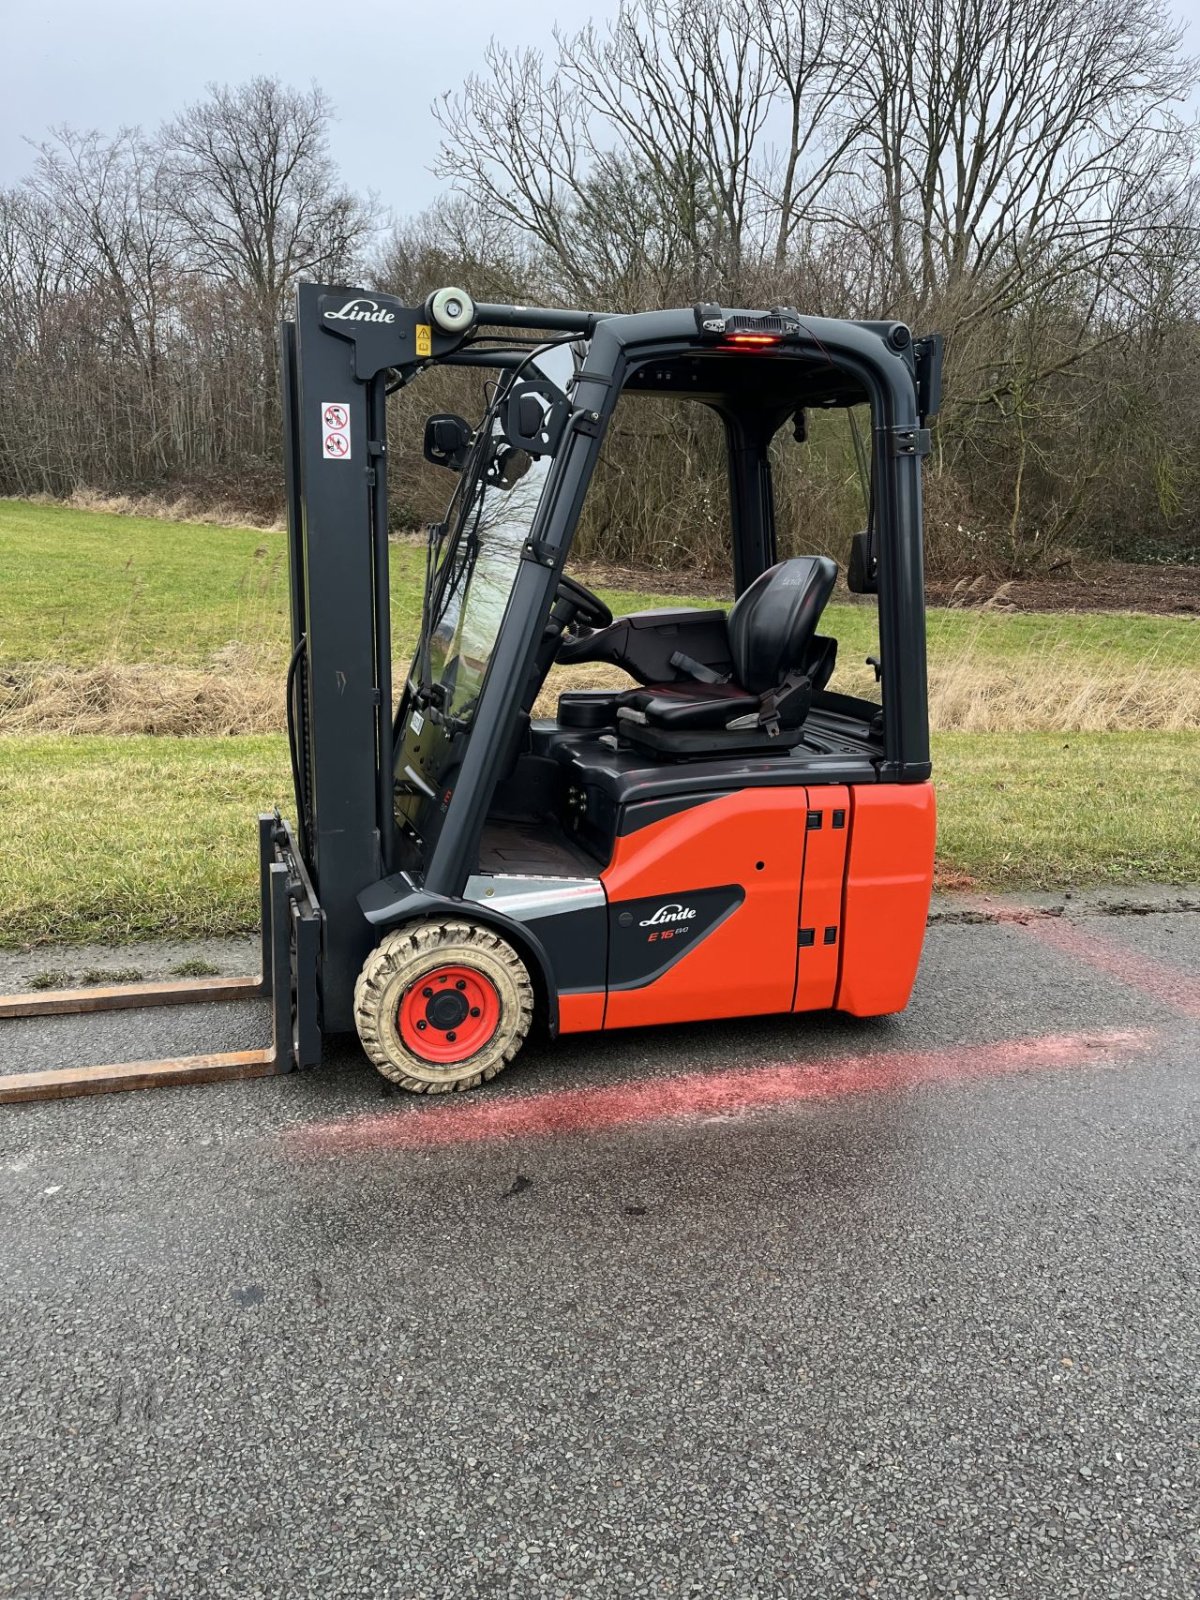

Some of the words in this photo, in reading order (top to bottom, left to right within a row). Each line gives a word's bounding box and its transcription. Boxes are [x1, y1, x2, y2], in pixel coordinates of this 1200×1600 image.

[324, 299, 395, 324] Linde
[639, 904, 696, 926] Linde
[648, 933, 658, 942] E
[661, 930, 675, 939] 16
